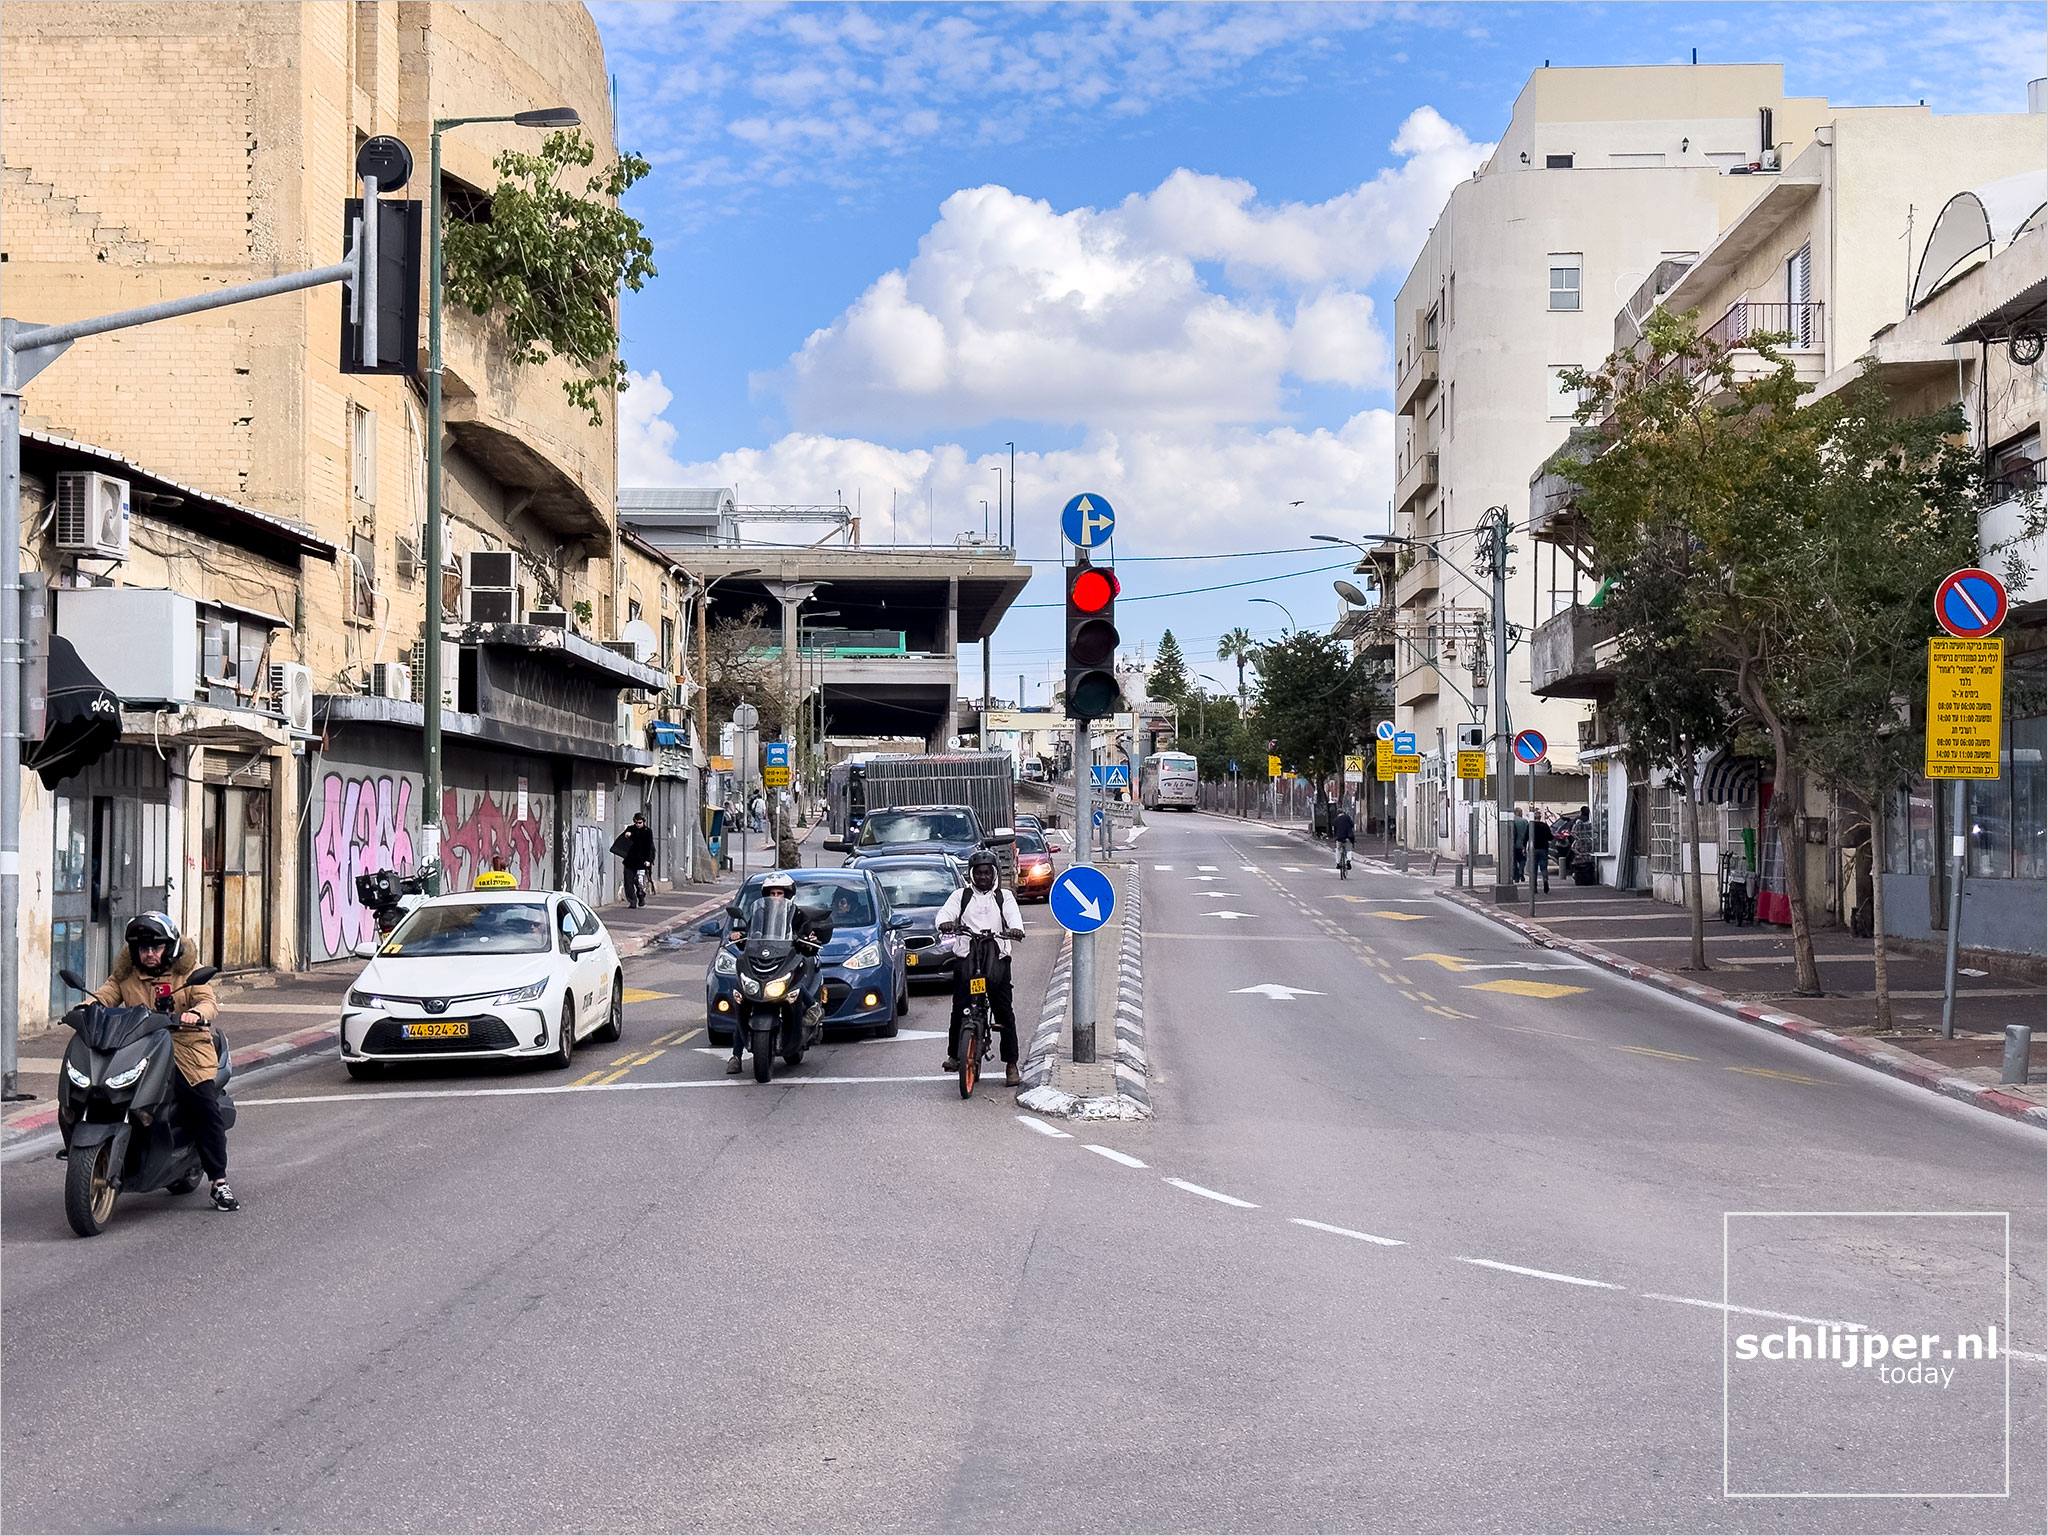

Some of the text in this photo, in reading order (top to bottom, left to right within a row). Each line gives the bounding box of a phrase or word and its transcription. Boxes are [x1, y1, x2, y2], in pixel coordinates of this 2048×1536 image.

[1978, 653, 1987, 662] רכב
[1959, 677, 1971, 686] בלבד
[1965, 689, 1979, 698] בימים
[1953, 702, 1960, 710] עד
[1976, 702, 1991, 710] משעה
[1937, 714, 1992, 722] ומשעה 11:00 עד 14:00
[1952, 726, 1958, 734] חג
[1952, 738, 1959, 746] עד
[1975, 738, 1991, 746] משעה
[1936, 750, 1991, 759] ומשעה 11:00 עד 14:00
[478, 878, 493, 886] taxi
